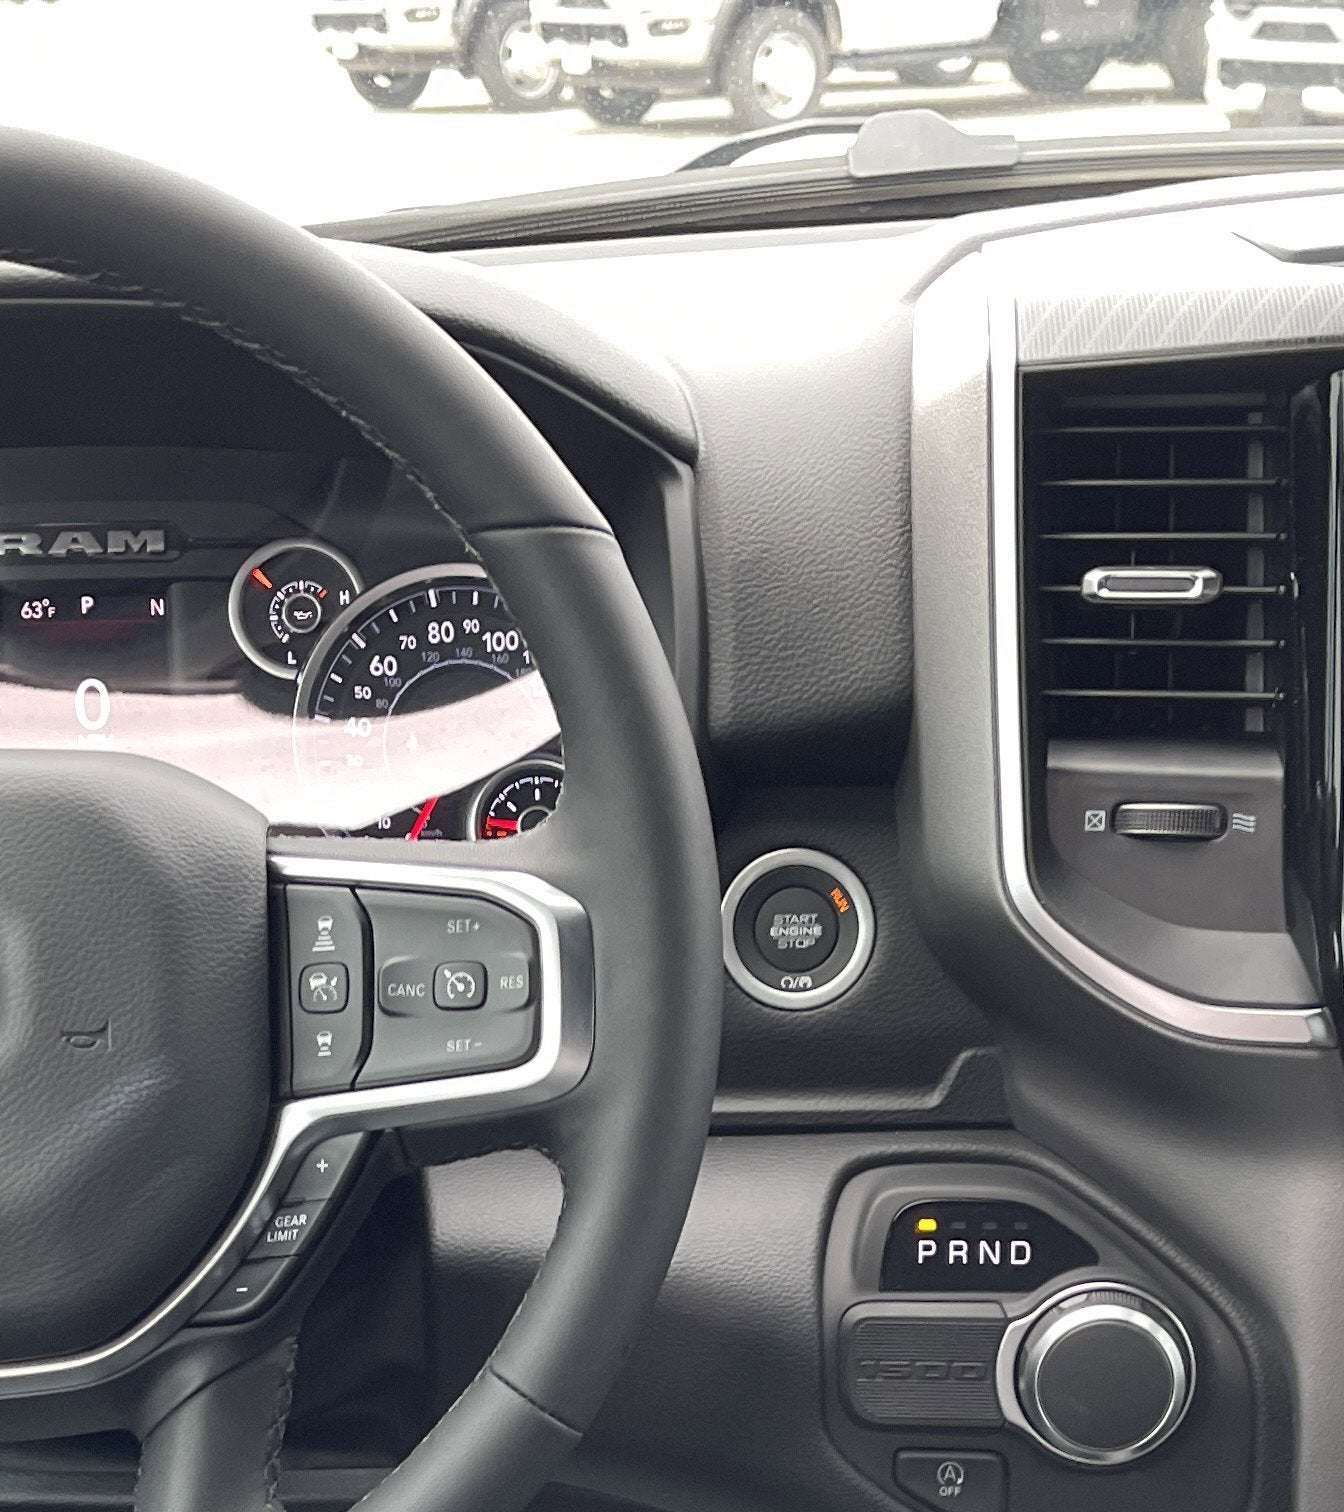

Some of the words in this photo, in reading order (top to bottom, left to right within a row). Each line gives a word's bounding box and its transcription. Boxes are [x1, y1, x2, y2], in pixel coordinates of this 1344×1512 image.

[80, 596, 94, 614] P
[340, 590, 351, 605] H
[150, 598, 165, 615] N
[427, 621, 454, 643] 80
[463, 618, 480, 634] 90
[399, 635, 416, 650] 70
[482, 630, 519, 652] 100
[288, 650, 297, 665] L
[421, 650, 440, 663] 120
[369, 655, 397, 677] 60
[354, 686, 372, 700] 50
[75, 678, 111, 731] 0
[344, 717, 372, 738] 40
[376, 817, 392, 830] 10
[773, 913, 818, 925] START
[770, 925, 823, 938] ENGINE
[777, 937, 816, 950] STOP
[387, 982, 426, 999] CANC
[500, 975, 524, 991] RES
[274, 1213, 307, 1228] GEAR
[266, 1228, 299, 1243] LIMIT
[938, 1486, 961, 1497] OFF
